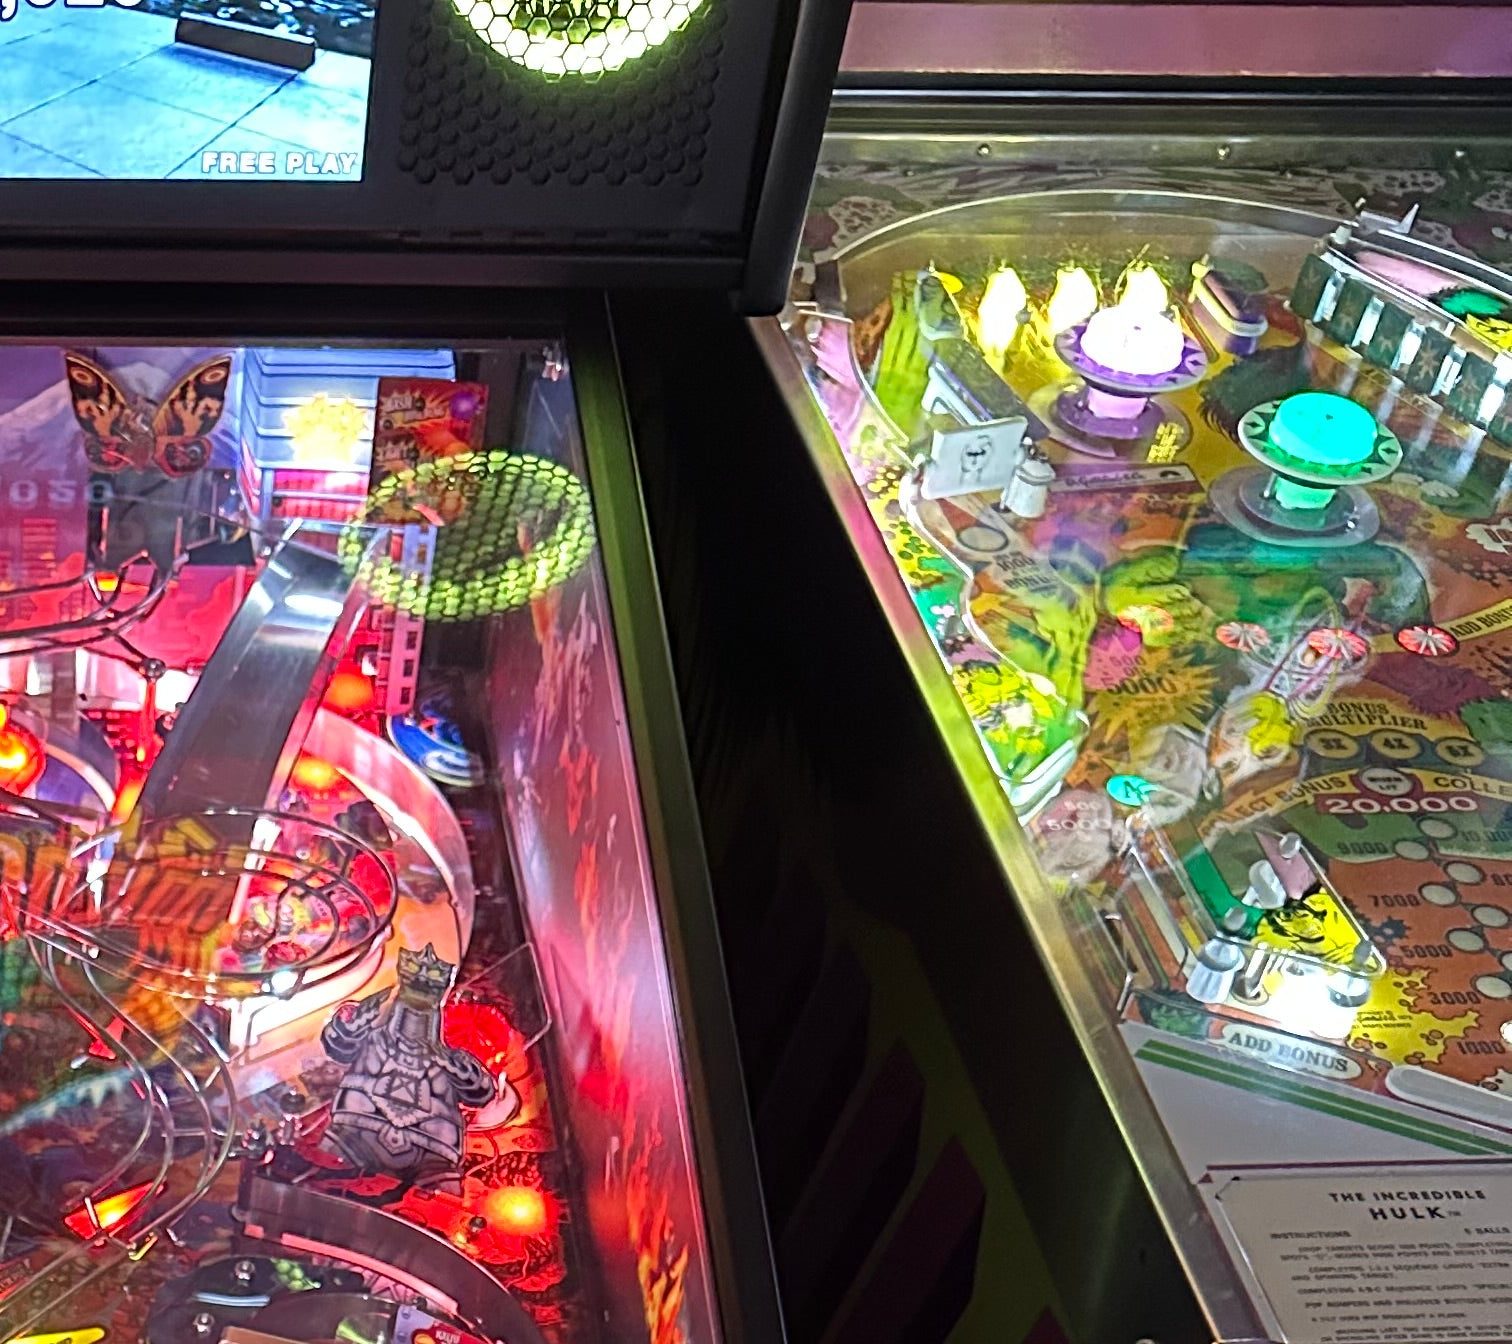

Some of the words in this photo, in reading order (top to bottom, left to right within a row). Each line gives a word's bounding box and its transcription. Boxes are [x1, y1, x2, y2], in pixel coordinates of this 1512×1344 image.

[201, 151, 276, 174] FREE
[286, 152, 357, 175] PLAY
[1450, 618, 1482, 638] ADD
[1228, 1030, 1272, 1053] ADD
[1278, 1045, 1348, 1072] BONUS
[1329, 1192, 1365, 1202] THE
[1373, 1190, 1487, 1201] INCREDIBLE
[1369, 1206, 1444, 1219] HULK
